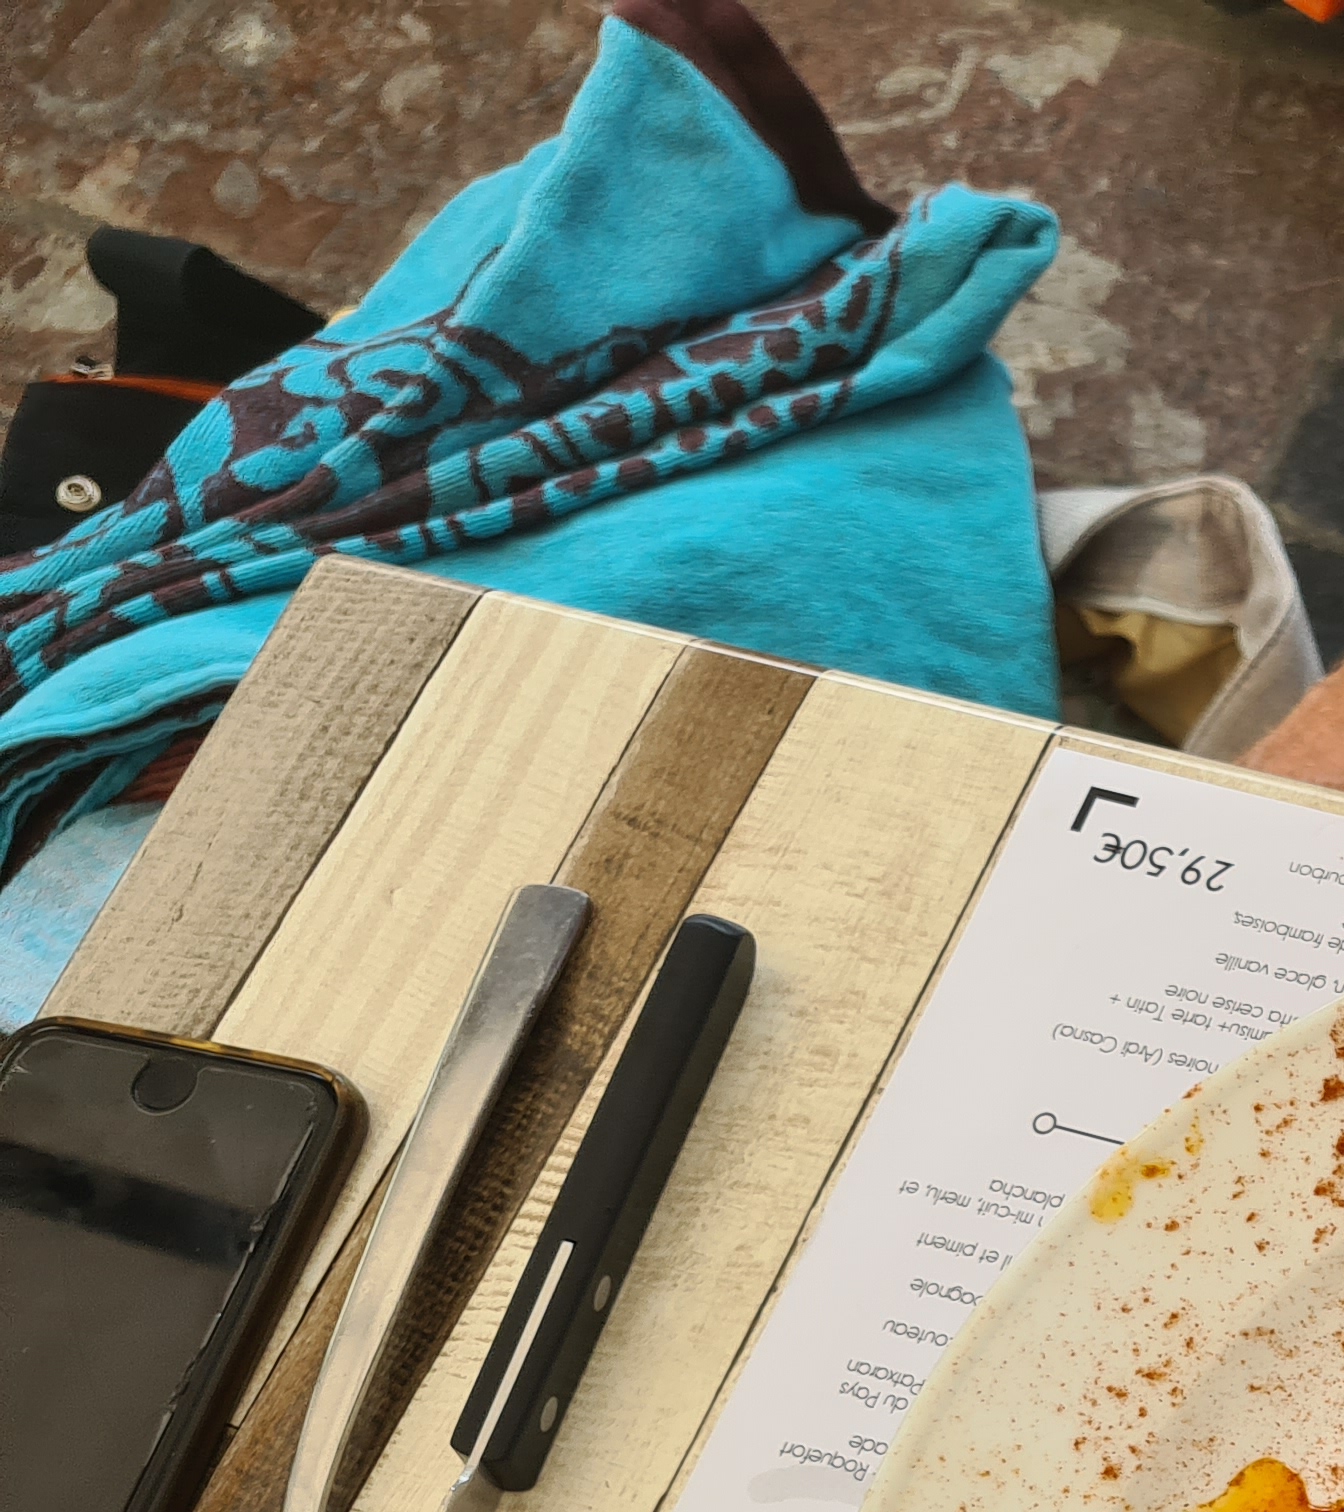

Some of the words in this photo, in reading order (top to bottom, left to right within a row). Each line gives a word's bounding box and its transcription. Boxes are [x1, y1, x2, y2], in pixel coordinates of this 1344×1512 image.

[1093, 832, 1234, 892] 29,50€
[1215, 953, 1269, 975] vanille
[1274, 967, 1327, 991] glace
[1165, 985, 1209, 1004] noire
[1126, 997, 1165, 1022] Tatin
[1171, 1008, 1212, 1031] tarte
[925, 1184, 971, 1208] merlu,
[989, 1179, 1065, 1210] plancha
[977, 1198, 1035, 1224] mi-cuit,
[916, 1233, 979, 1257] piment
[839, 1382, 881, 1409] Pays
[779, 1442, 869, 1482] Roquefort
